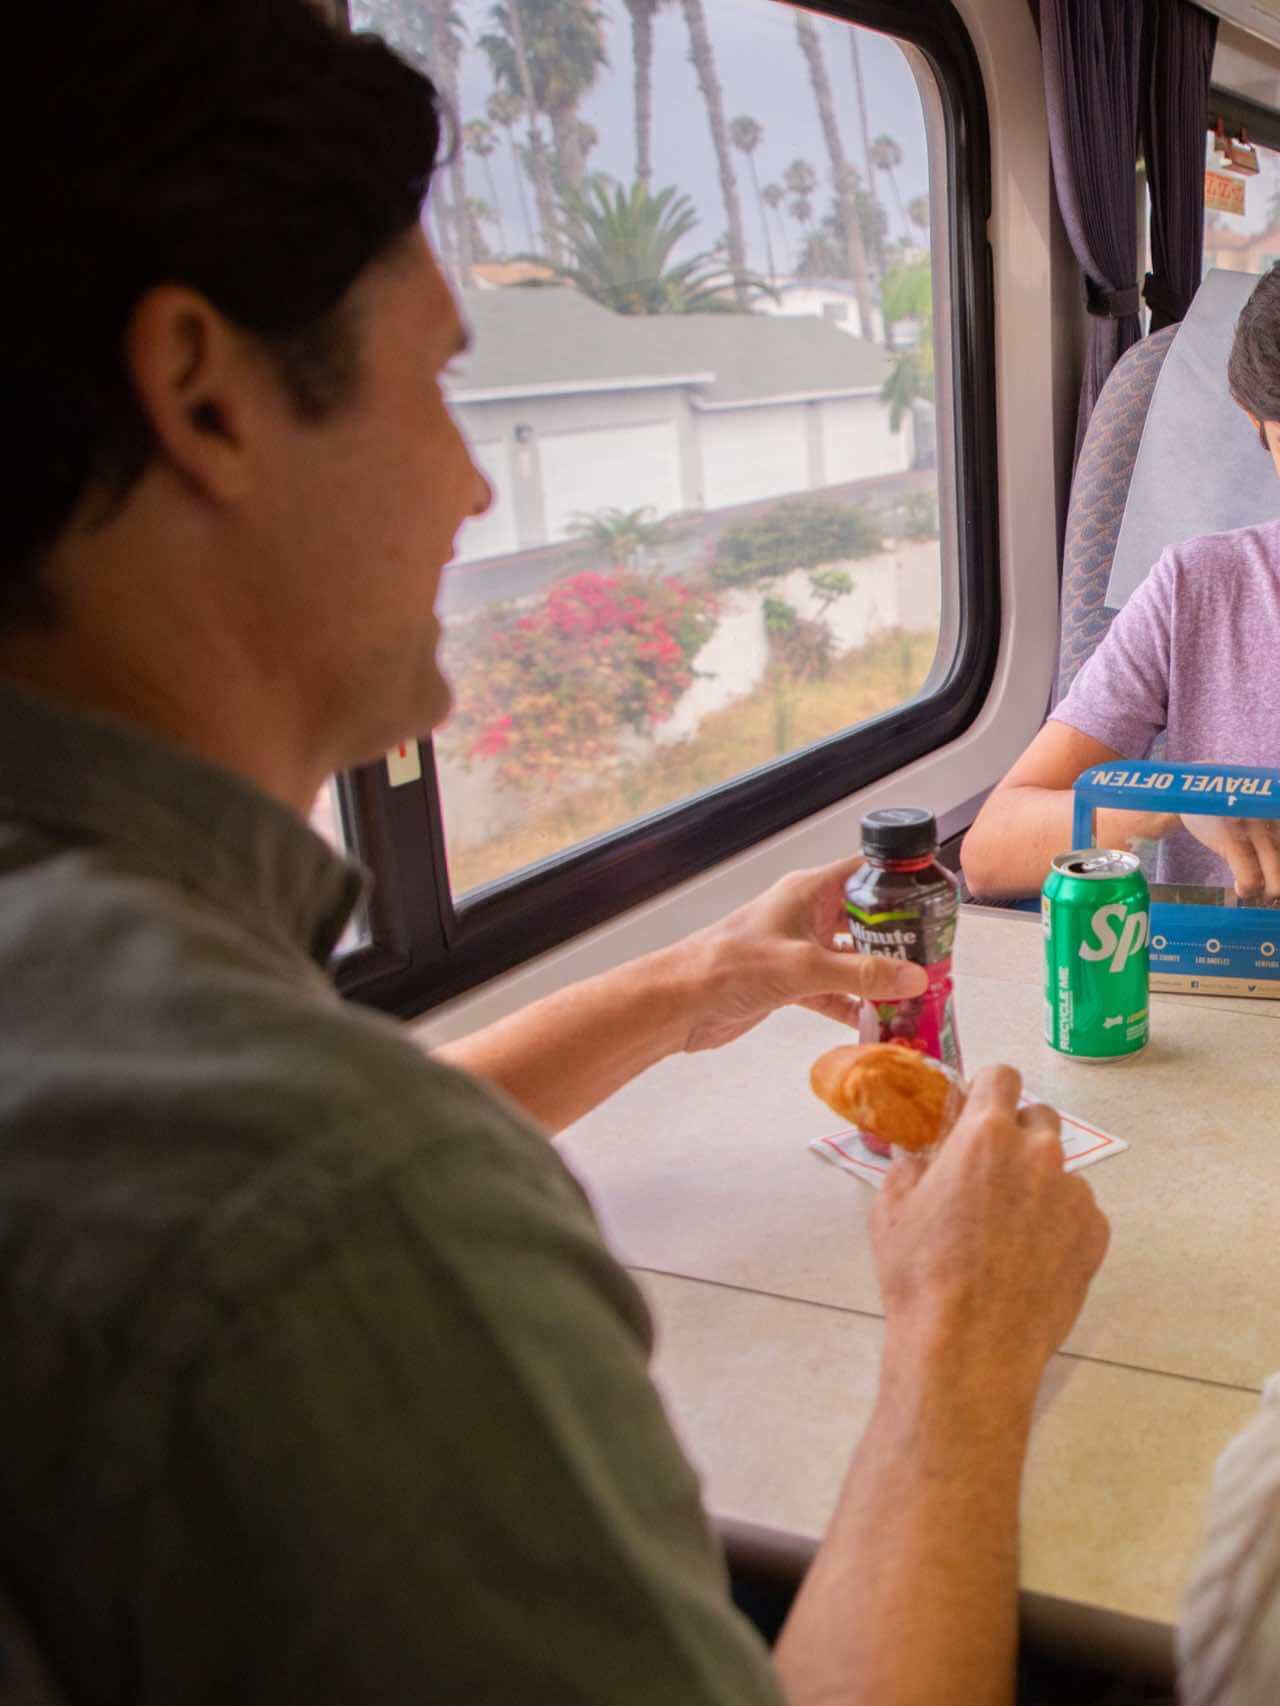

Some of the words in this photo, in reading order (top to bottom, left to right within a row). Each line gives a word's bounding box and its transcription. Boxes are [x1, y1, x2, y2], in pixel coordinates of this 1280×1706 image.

[1091, 770, 1174, 789] OFTEN.
[1181, 774, 1272, 796] TRAVEL
[847, 917, 917, 945] Minute
[1078, 903, 1149, 973] Sp
[1058, 989, 1070, 1051] RECYCLE
